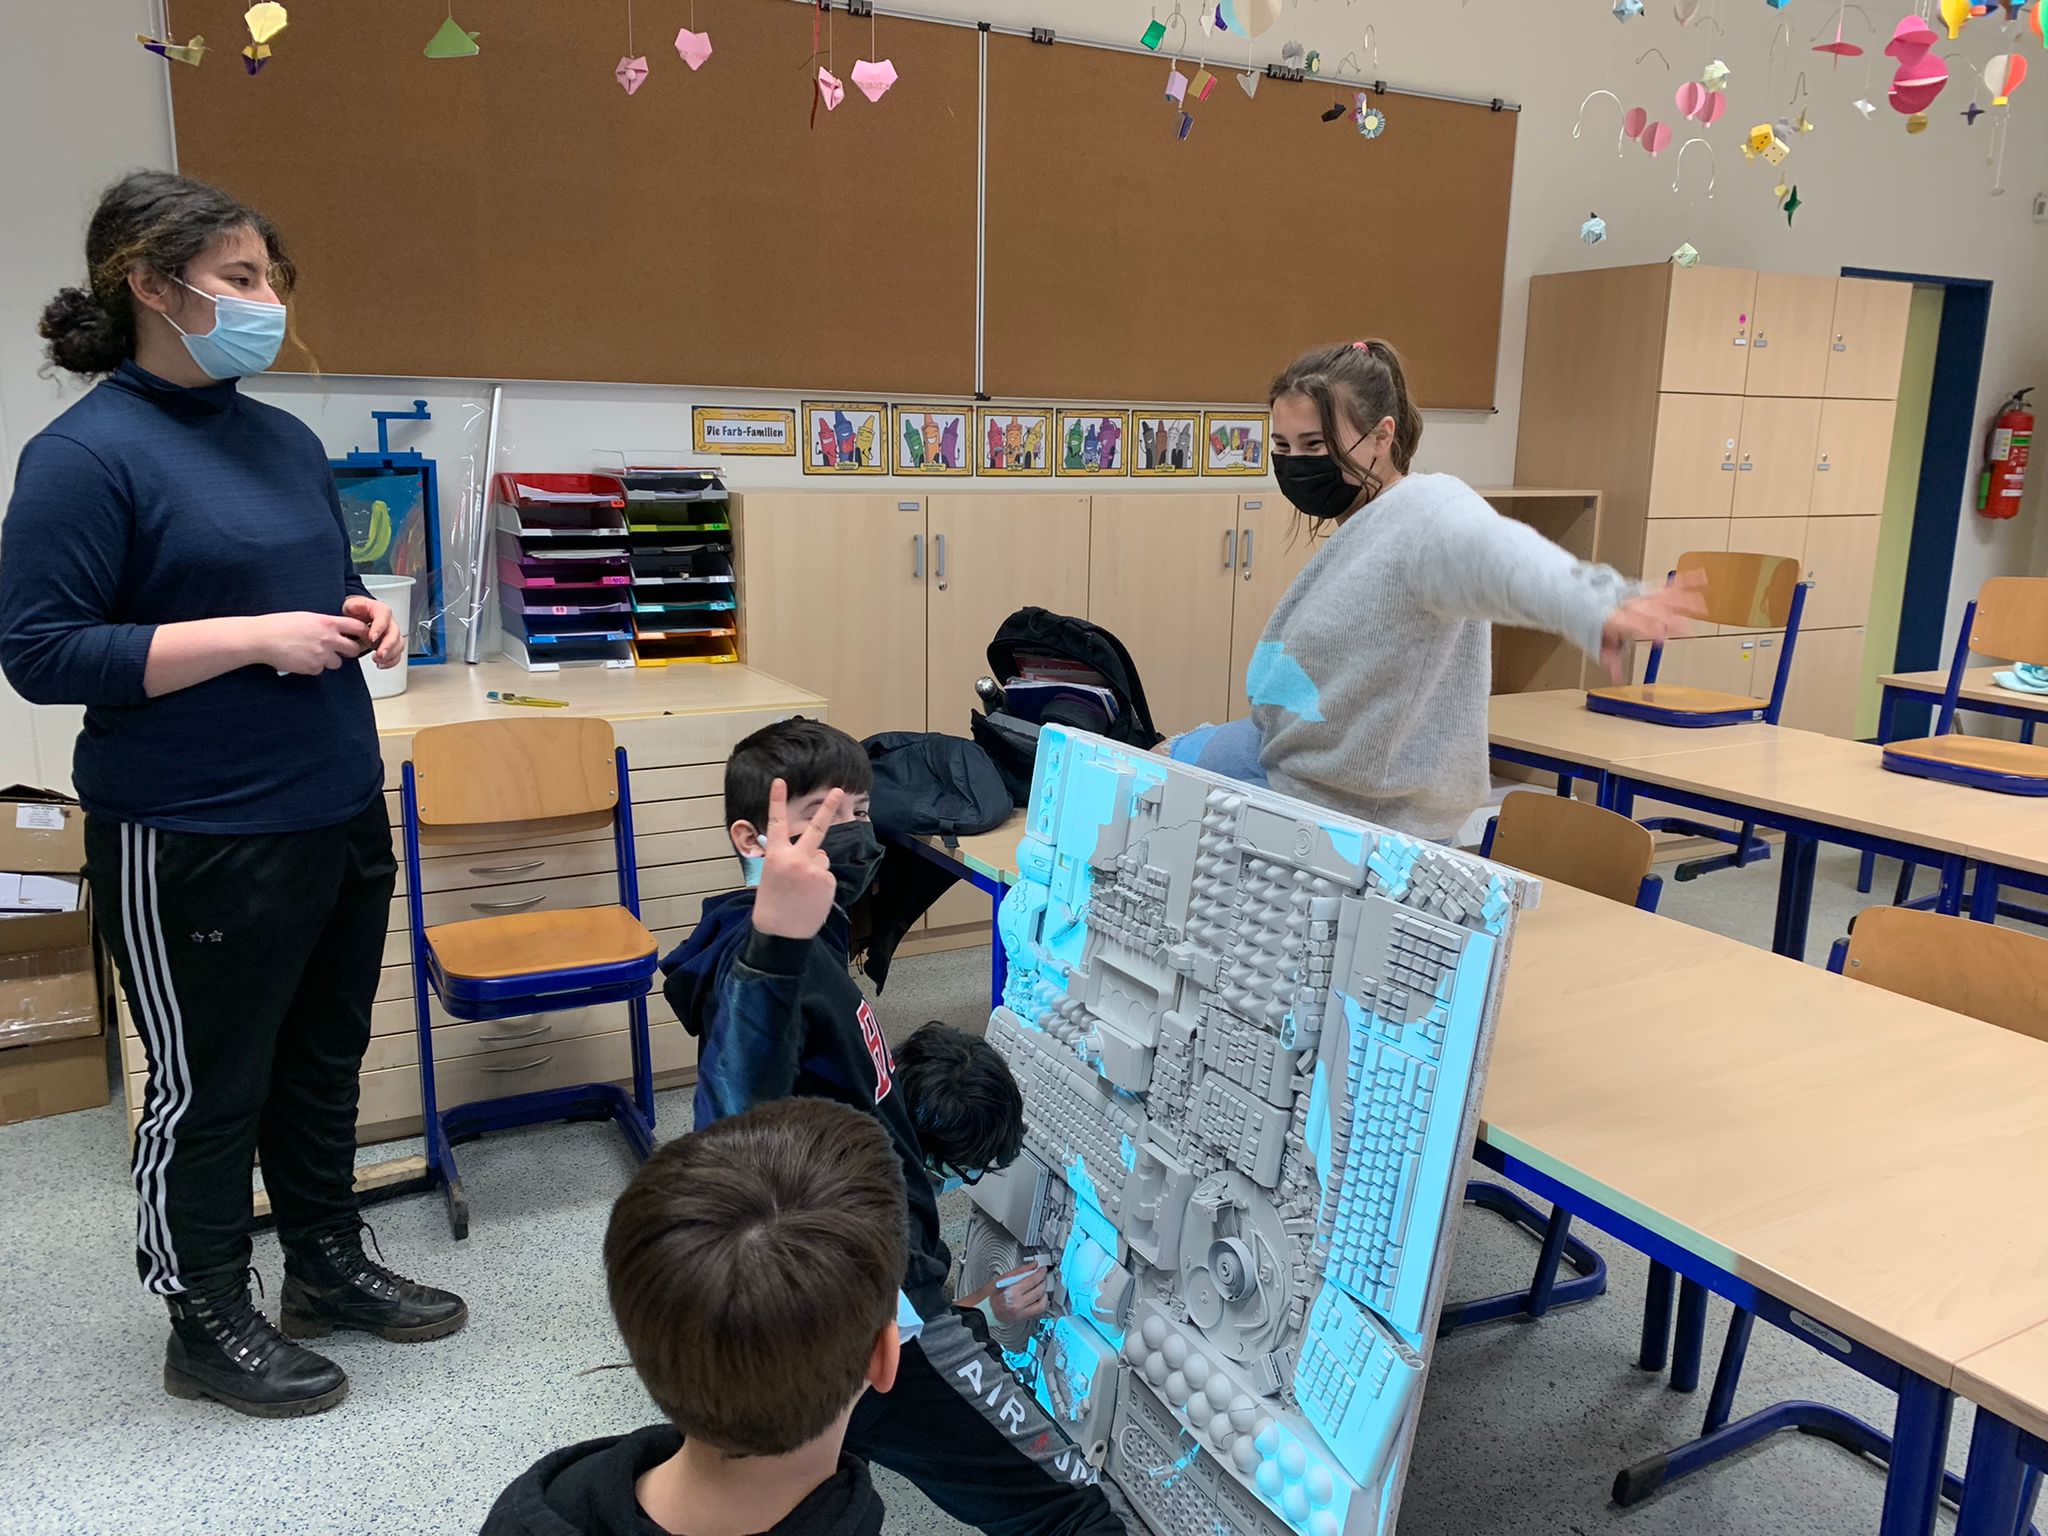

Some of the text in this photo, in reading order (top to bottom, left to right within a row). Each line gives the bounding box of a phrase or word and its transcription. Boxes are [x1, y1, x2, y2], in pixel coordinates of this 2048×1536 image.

[706, 425, 784, 438] Die Farb-Familien
[956, 1359, 1026, 1435] AIR
